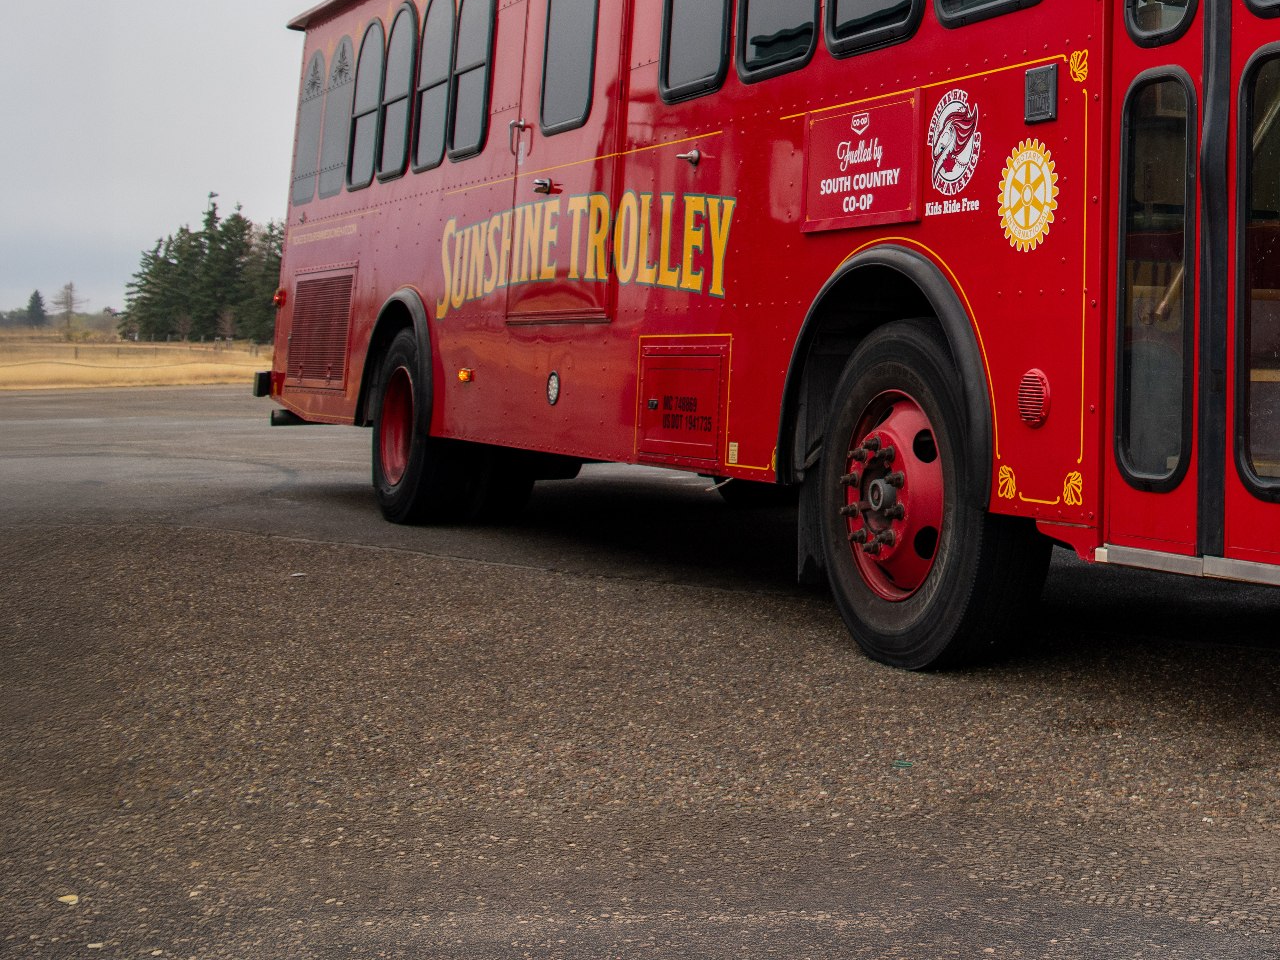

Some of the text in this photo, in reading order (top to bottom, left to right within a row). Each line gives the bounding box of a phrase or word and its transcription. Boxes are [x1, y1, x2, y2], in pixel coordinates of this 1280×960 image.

[852, 117, 868, 127] CO-OP
[927, 91, 952, 146] MEDICINE
[837, 137, 883, 172] Fuelled by
[934, 132, 982, 196] MAVERICKS
[1015, 151, 1041, 165] ROTARY
[820, 167, 901, 195] SOUTH COUNTRY
[842, 193, 873, 213] CO-OP
[925, 197, 980, 217] Kids Ride Free
[1006, 207, 1050, 239] INTERNATIONAL
[436, 189, 737, 320] SUNSHINE TROLLEY
[663, 395, 673, 411] MC
